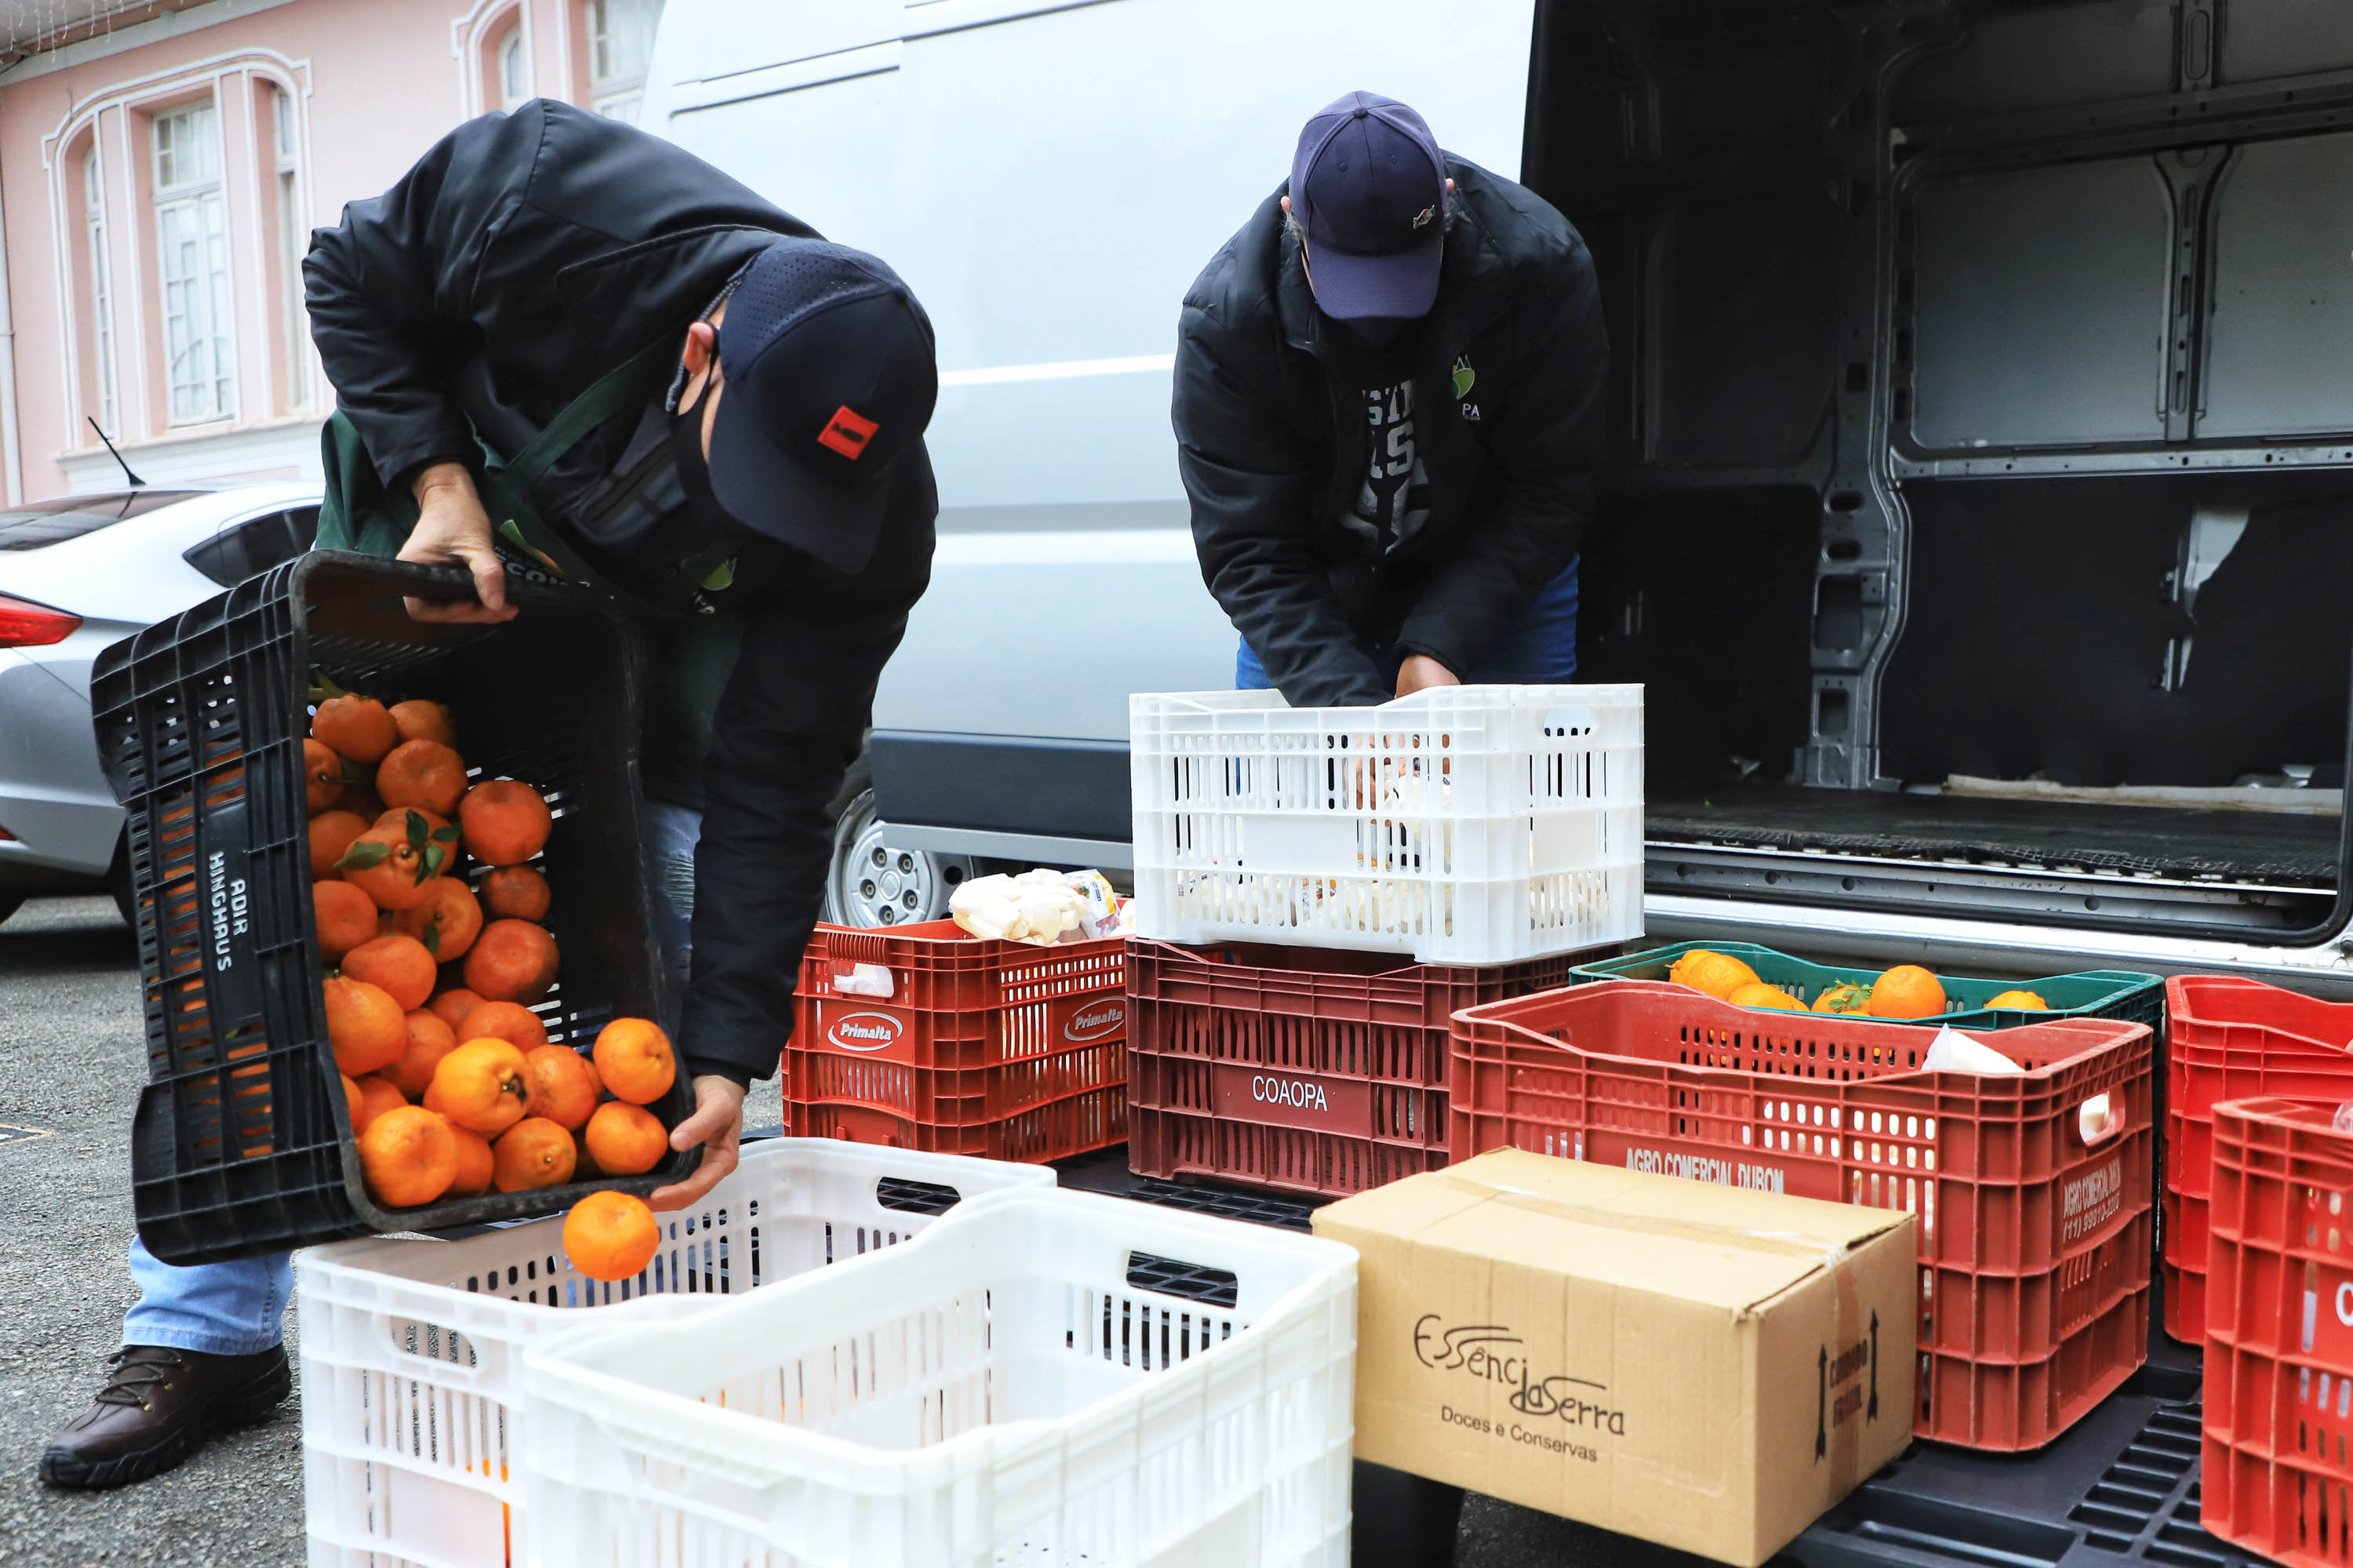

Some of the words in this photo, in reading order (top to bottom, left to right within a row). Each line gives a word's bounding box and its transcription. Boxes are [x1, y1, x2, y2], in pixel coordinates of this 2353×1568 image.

[209, 849, 232, 973] HINGHAUS
[230, 878, 249, 937] ADIR
[840, 1022, 892, 1041] Primalta
[1075, 1008, 1123, 1031] Primalta
[1251, 1074, 1329, 1112] COAOPA
[1625, 1148, 1662, 1174] AGRO
[2064, 1179, 2082, 1219] AGRO
[2064, 1216, 2082, 1244] (11)
[1440, 1405, 1491, 1433] Doces
[1495, 1424, 1505, 1437] e
[1510, 1424, 1598, 1463] Conservas
